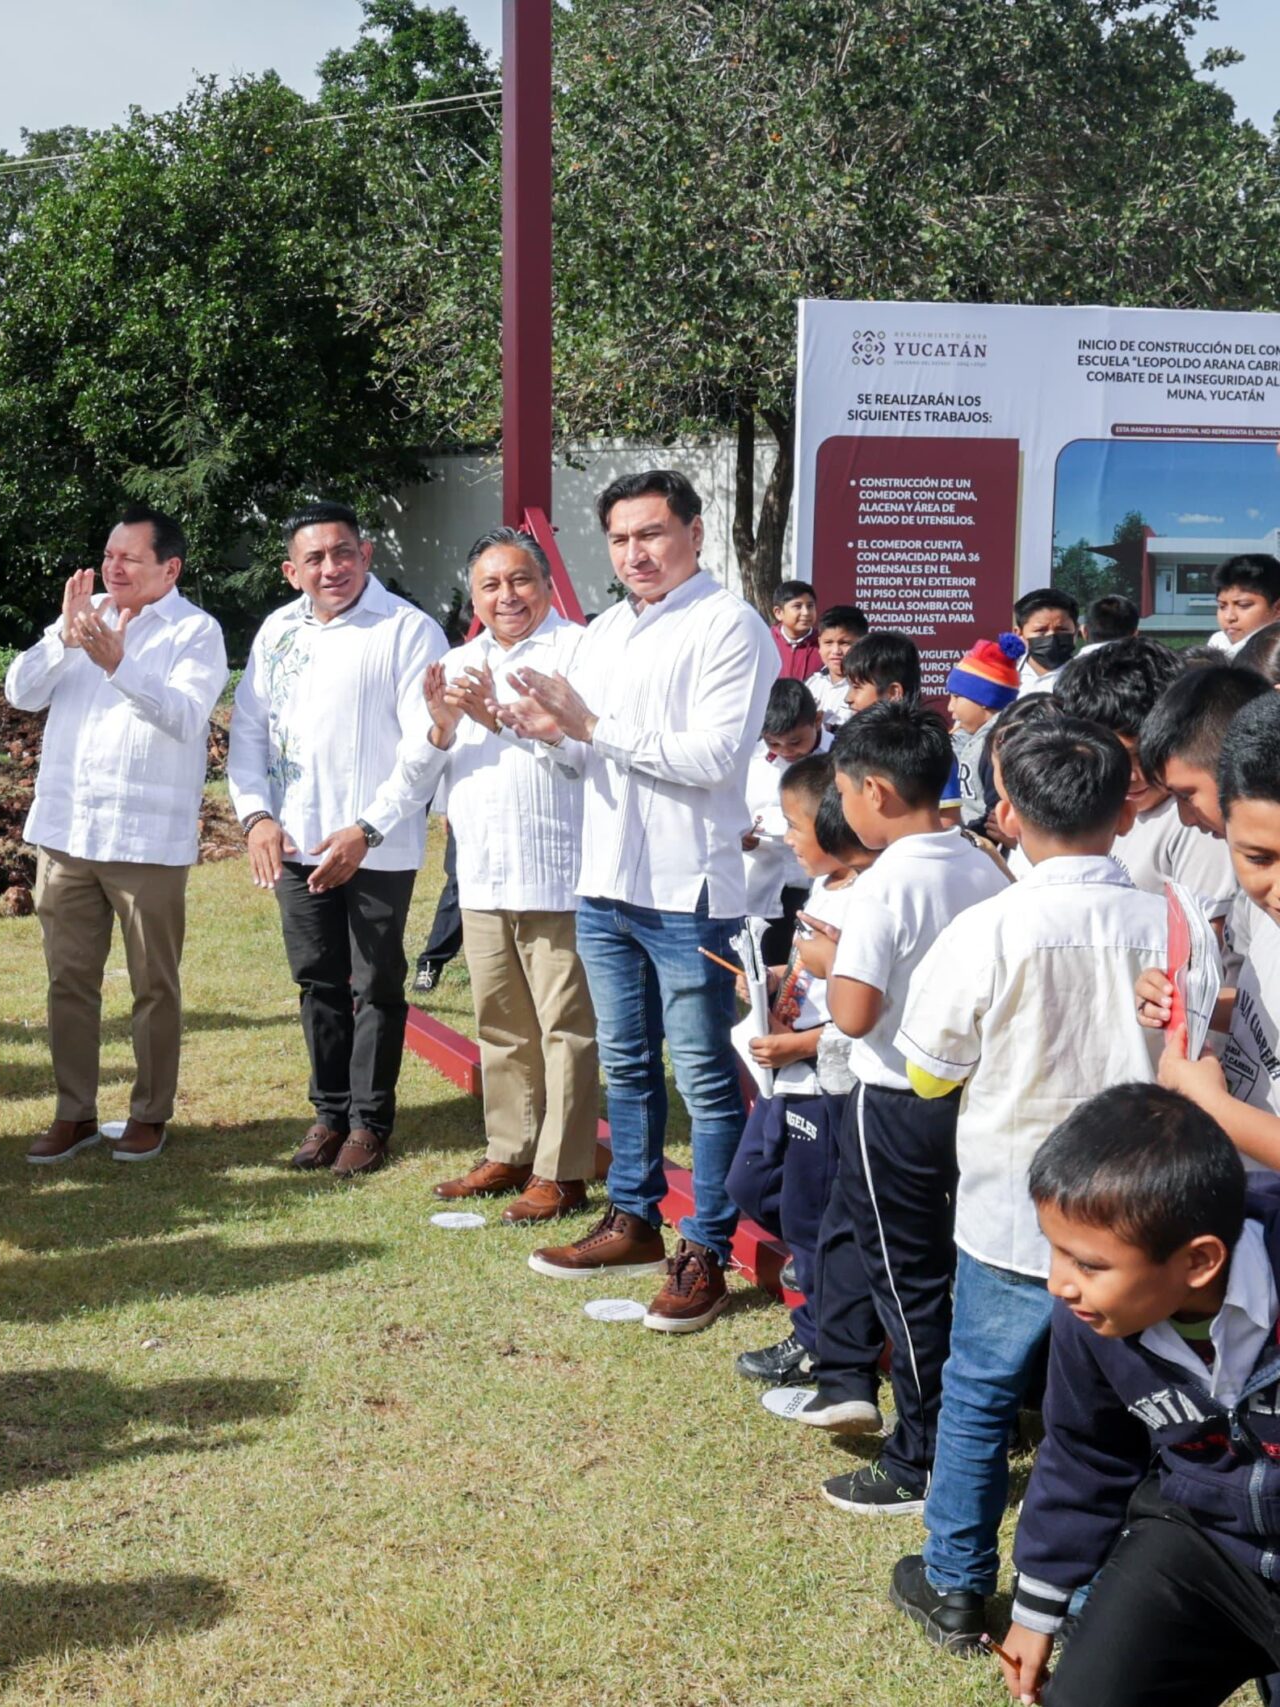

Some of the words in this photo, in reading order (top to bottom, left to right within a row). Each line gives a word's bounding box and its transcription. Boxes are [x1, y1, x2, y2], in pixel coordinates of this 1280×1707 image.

[894, 341, 987, 358] YUCATÁN
[1078, 339, 1117, 351] INICIO
[1120, 340, 1135, 351] DE
[1138, 340, 1232, 354] CONSTRUCCIÓN
[1235, 343, 1256, 355] DEL
[1077, 355, 1130, 367] ESCUELA
[1203, 359, 1245, 370] ARANA
[1086, 371, 1145, 383] COMBATE
[1148, 373, 1164, 383] DE
[1166, 373, 1181, 384] LA
[1183, 374, 1263, 386] INSEGURIDAD
[1265, 376, 1280, 387] AL
[857, 393, 872, 405] SE
[875, 392, 955, 406] REALIZARÁN
[958, 395, 981, 407] LOS
[1167, 389, 1207, 401] MUNA,
[1209, 388, 1265, 401] YUCATÁN
[847, 409, 921, 422] SIGUIENTES
[924, 411, 993, 423] TRABAJOS:
[859, 477, 938, 488] CONSTRUCCIÓN
[941, 479, 954, 488] DE
[956, 479, 971, 488] UN
[859, 490, 911, 500] COMEDOR
[913, 491, 935, 500] CON
[937, 491, 978, 502] COCINA,
[858, 503, 905, 512] ALACENA
[905, 503, 914, 512] Y
[914, 501, 940, 512] ÁREA
[942, 503, 956, 512] DE
[858, 515, 899, 524] LAVADO
[901, 515, 915, 525] DE
[916, 516, 976, 525] UTENSILIOS.
[857, 540, 869, 549] EL
[870, 540, 922, 549] COMEDOR
[923, 540, 963, 549] CUENTA
[857, 552, 879, 561] CON
[881, 552, 938, 561] CAPACIDAD
[940, 553, 966, 562] PARA
[968, 553, 980, 562] 36
[856, 564, 922, 574] COMENSALES
[924, 565, 938, 574] EN
[940, 565, 951, 574] EL
[856, 577, 903, 586] INTERIOR
[903, 577, 912, 586] Y
[913, 577, 927, 586] EN
[928, 577, 976, 586] EXTERIOR
[856, 589, 871, 598] UN
[873, 589, 897, 598] PISO
[898, 589, 920, 598] CON
[922, 589, 969, 598] CUBIERTA
[855, 601, 869, 610] DE
[871, 601, 905, 611] MALLA
[906, 601, 949, 611] SOMBRA
[951, 602, 973, 611] CON
[914, 613, 947, 623] HASTA
[948, 613, 975, 623] PARA
[918, 650, 960, 659] VIGUETA
